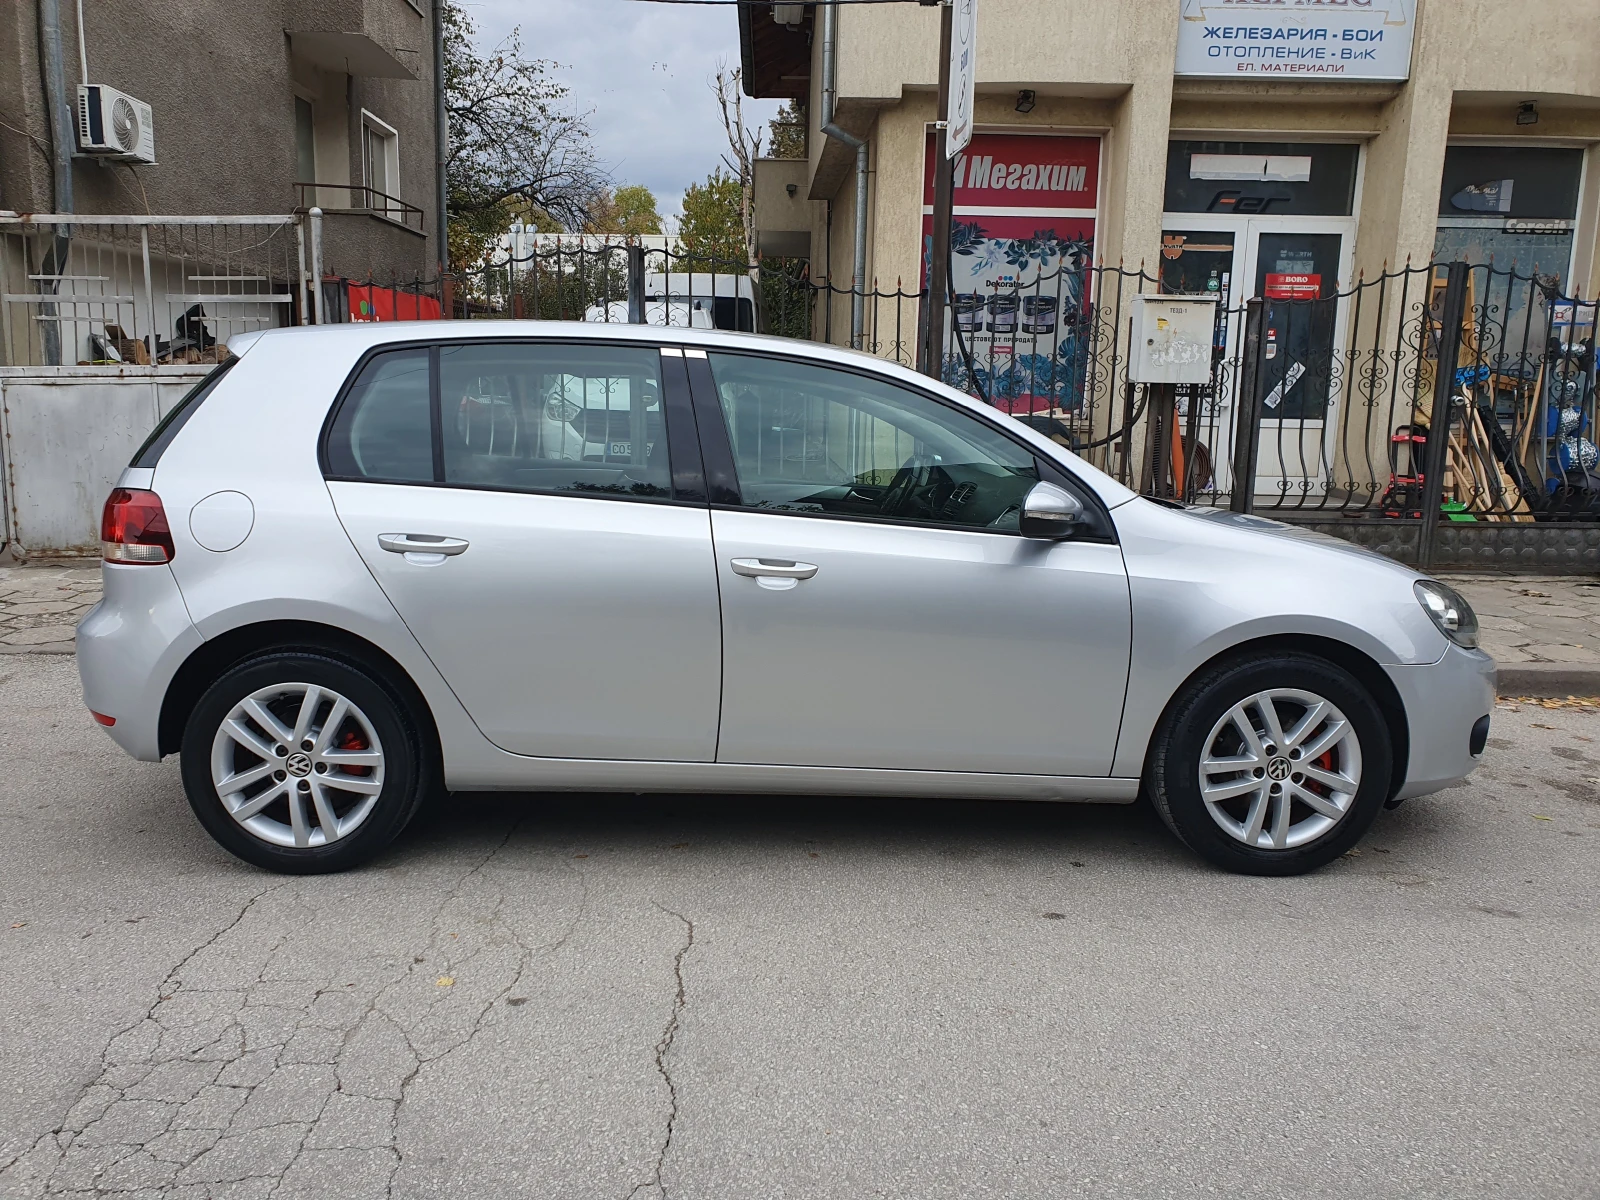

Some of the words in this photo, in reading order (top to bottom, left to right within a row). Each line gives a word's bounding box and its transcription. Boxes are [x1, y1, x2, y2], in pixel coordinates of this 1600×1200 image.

[1202, 26, 1327, 41] ЖЕЛЕЗАРИЯ
[1342, 29, 1383, 42] БОИ
[1208, 45, 1326, 59] ОТОПЛЕНИЕ
[1340, 48, 1377, 60] ВиК
[1237, 63, 1257, 71] ЕЛ.
[1260, 63, 1345, 73] МАТЕРИАЛИ
[968, 155, 1086, 192] Мегахим
[1206, 189, 1291, 214] Fer
